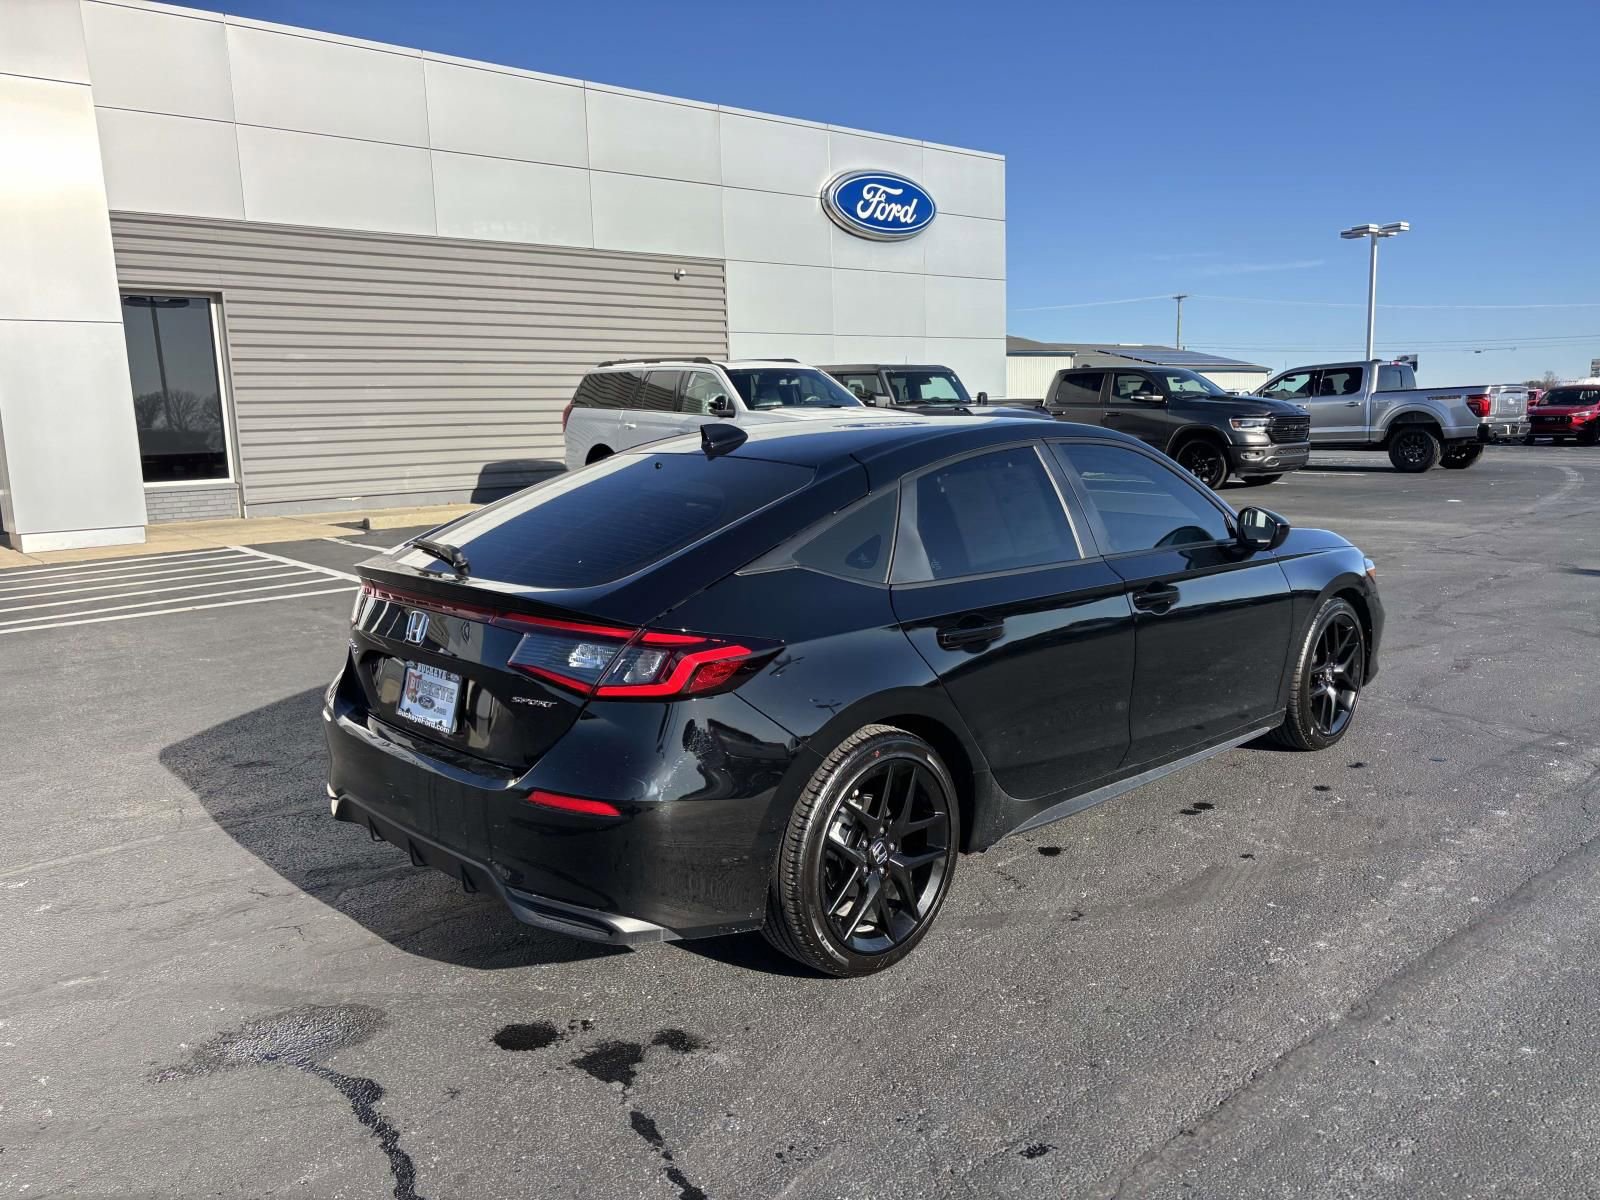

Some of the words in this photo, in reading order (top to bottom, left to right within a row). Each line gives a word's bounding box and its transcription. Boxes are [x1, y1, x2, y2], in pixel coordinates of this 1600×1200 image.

[857, 183, 918, 224] Ford
[511, 696, 558, 708] SPORT
[397, 709, 450, 734] BuckeyeFord.com
